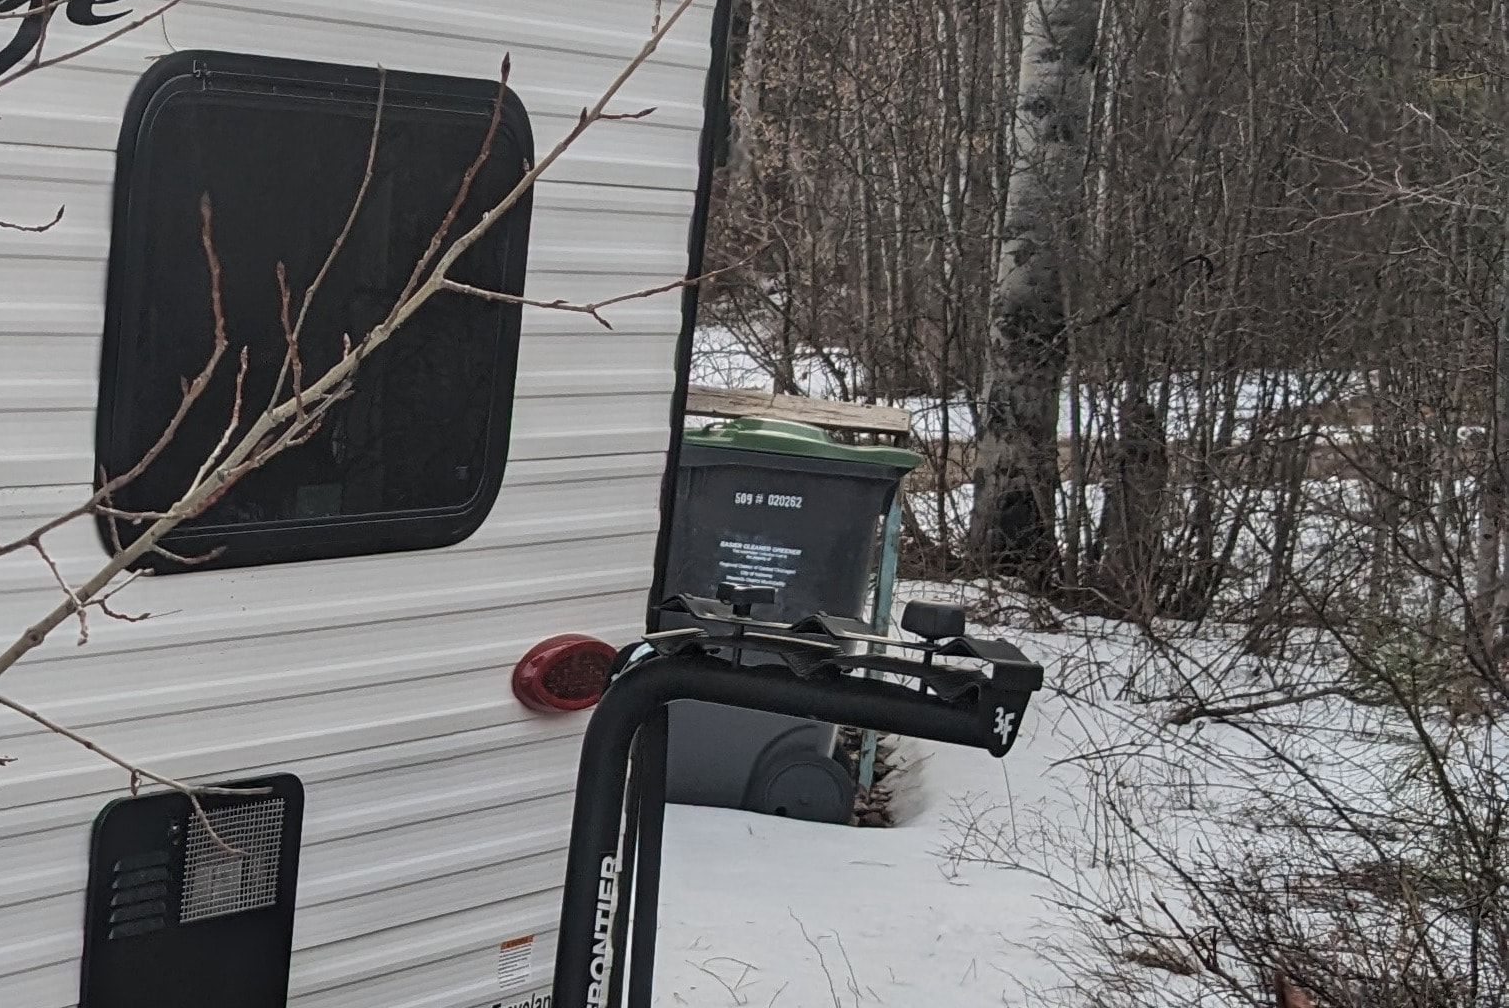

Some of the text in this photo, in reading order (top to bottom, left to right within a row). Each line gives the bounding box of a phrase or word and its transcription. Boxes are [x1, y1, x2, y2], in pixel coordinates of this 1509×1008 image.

[734, 492, 753, 505] 509
[767, 494, 803, 509] 020262
[587, 855, 617, 1008] RONTIER
